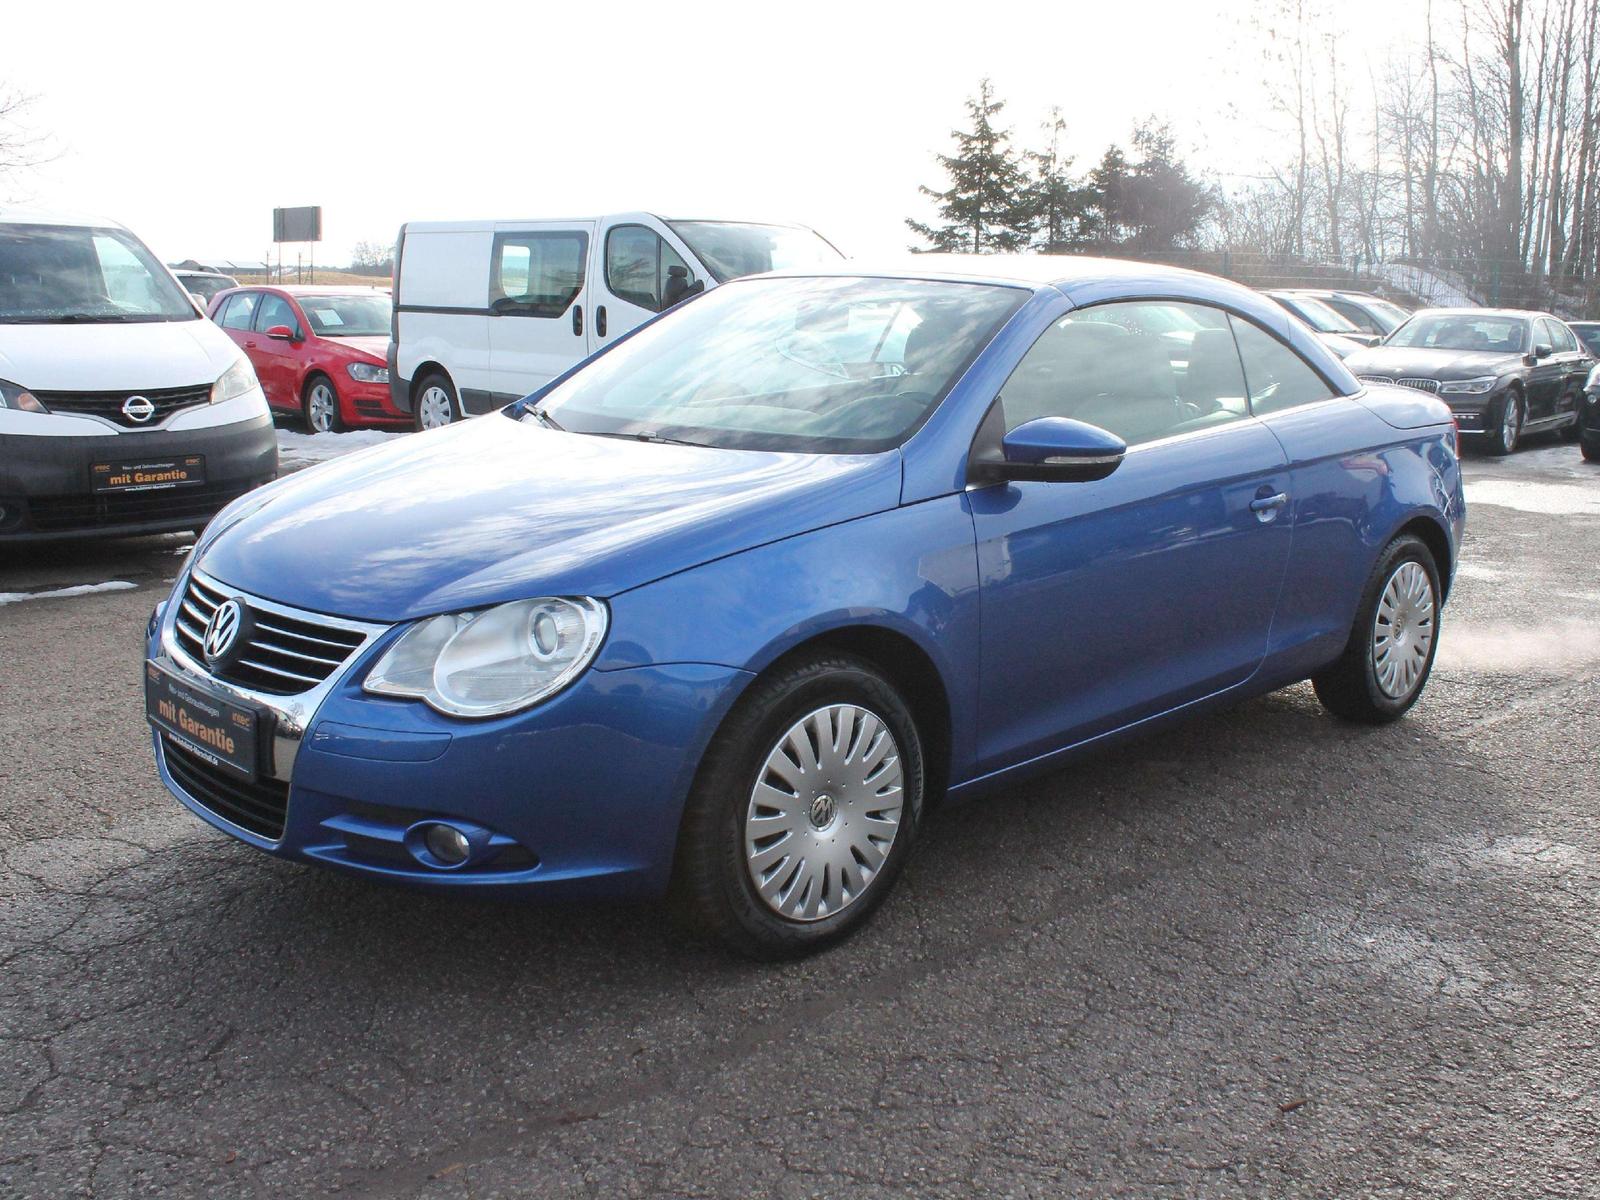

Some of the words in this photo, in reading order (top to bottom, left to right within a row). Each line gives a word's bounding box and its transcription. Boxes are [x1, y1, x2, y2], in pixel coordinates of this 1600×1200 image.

[110, 473, 131, 485] mit
[135, 469, 187, 483] Garantie
[159, 699, 176, 724] mit
[179, 707, 235, 754] Garantie
